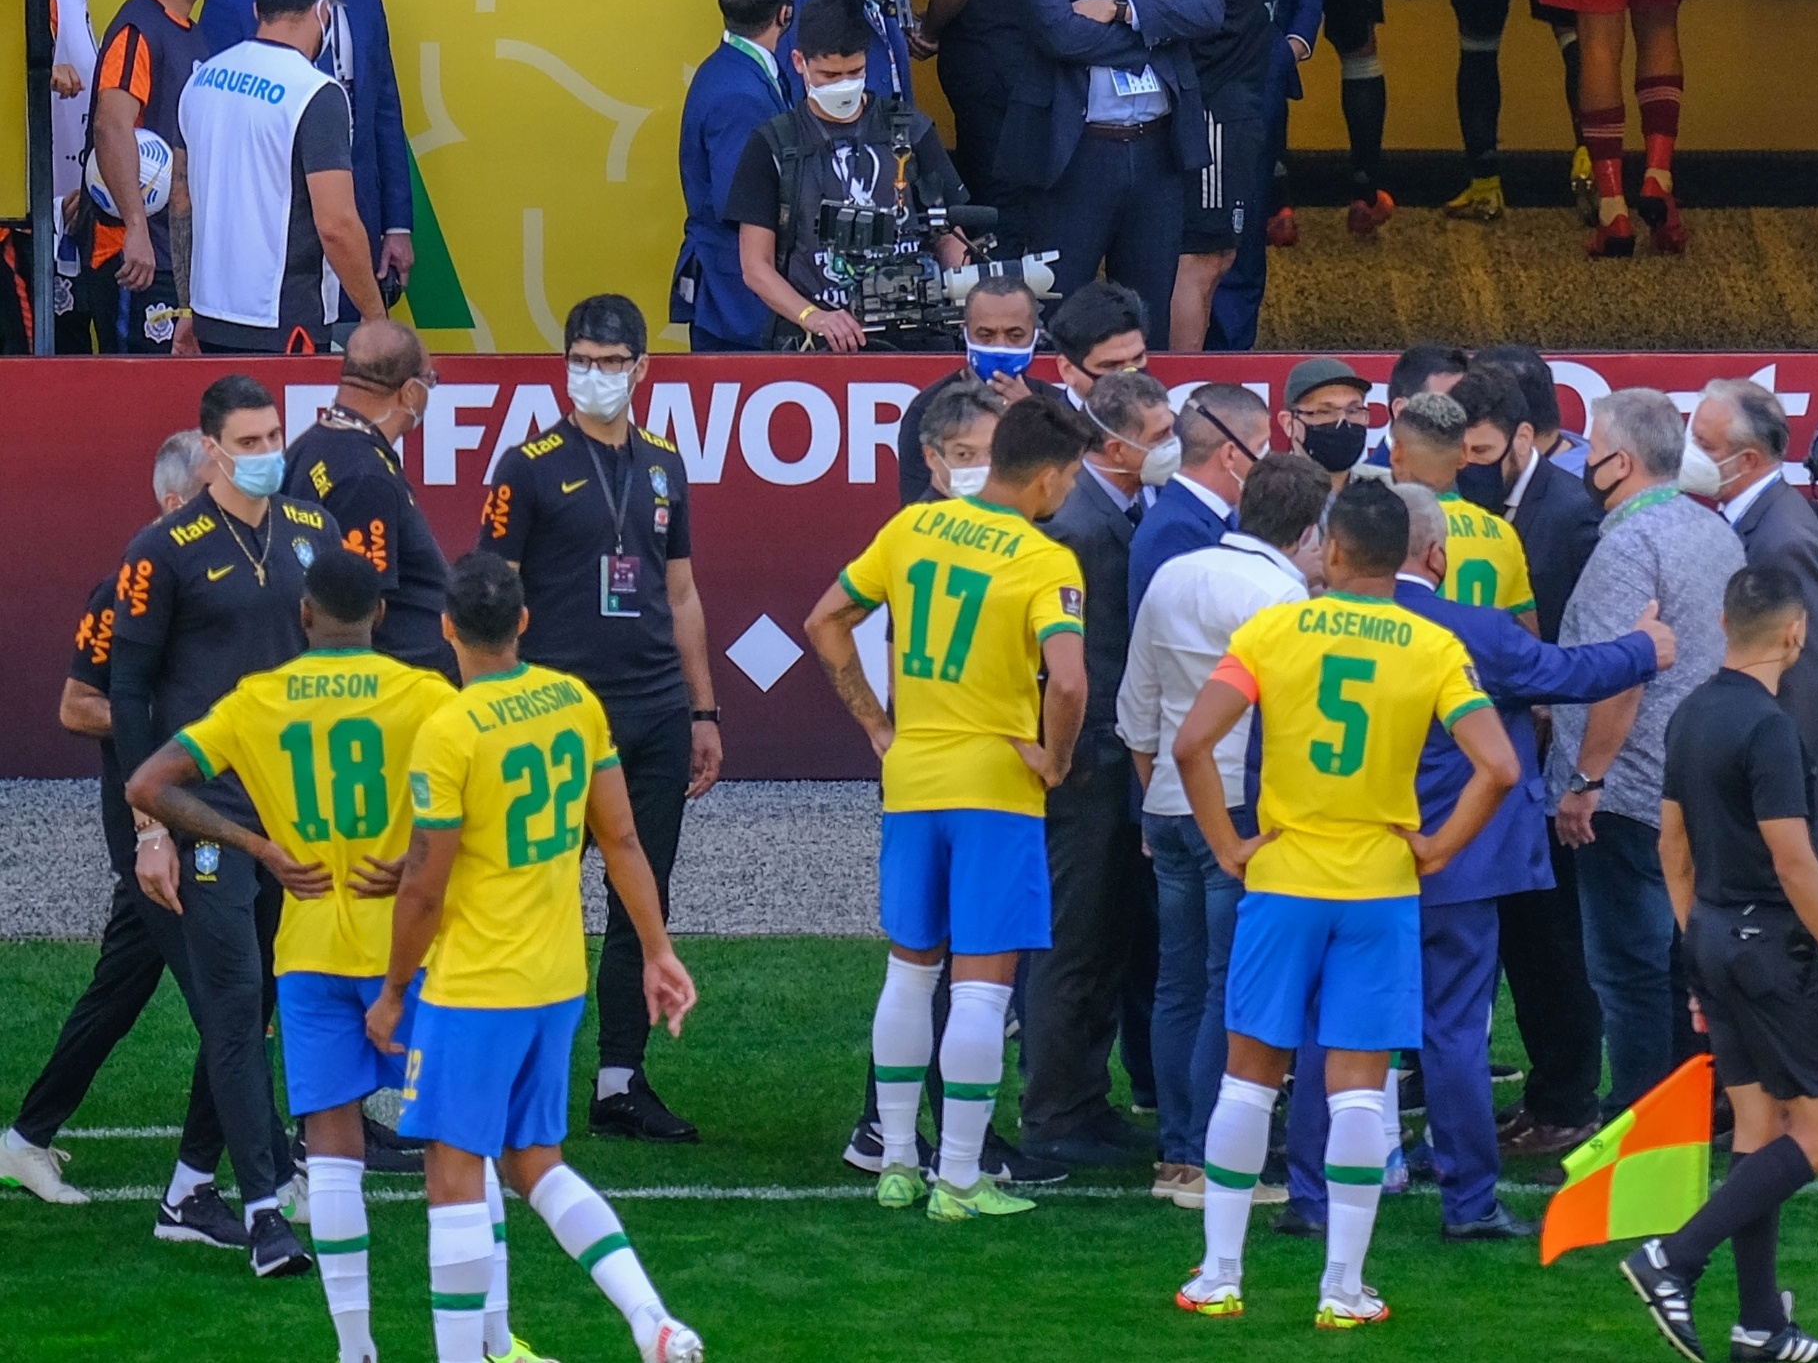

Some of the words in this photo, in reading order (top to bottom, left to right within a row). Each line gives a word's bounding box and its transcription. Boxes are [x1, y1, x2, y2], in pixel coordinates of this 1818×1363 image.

[193, 68, 286, 105] MAQUEIRO
[520, 431, 565, 461] Itaú
[637, 426, 677, 454] Itaú
[169, 513, 217, 548] Itaú
[281, 502, 325, 531] Itaú
[491, 483, 513, 540] vivo
[912, 508, 1025, 559] L.PAQUETÁ
[1482, 516, 1503, 539] JR
[366, 517, 390, 573] vivo
[129, 559, 154, 618] vivo
[91, 607, 116, 665] vivo
[902, 557, 993, 684] 17
[1297, 608, 1413, 648] CASEMIRO
[286, 673, 380, 702] GERSON
[466, 679, 584, 733] L.VERÍSSIMO
[1308, 653, 1377, 778] 5
[279, 716, 390, 844] 18
[501, 727, 587, 869] 22
